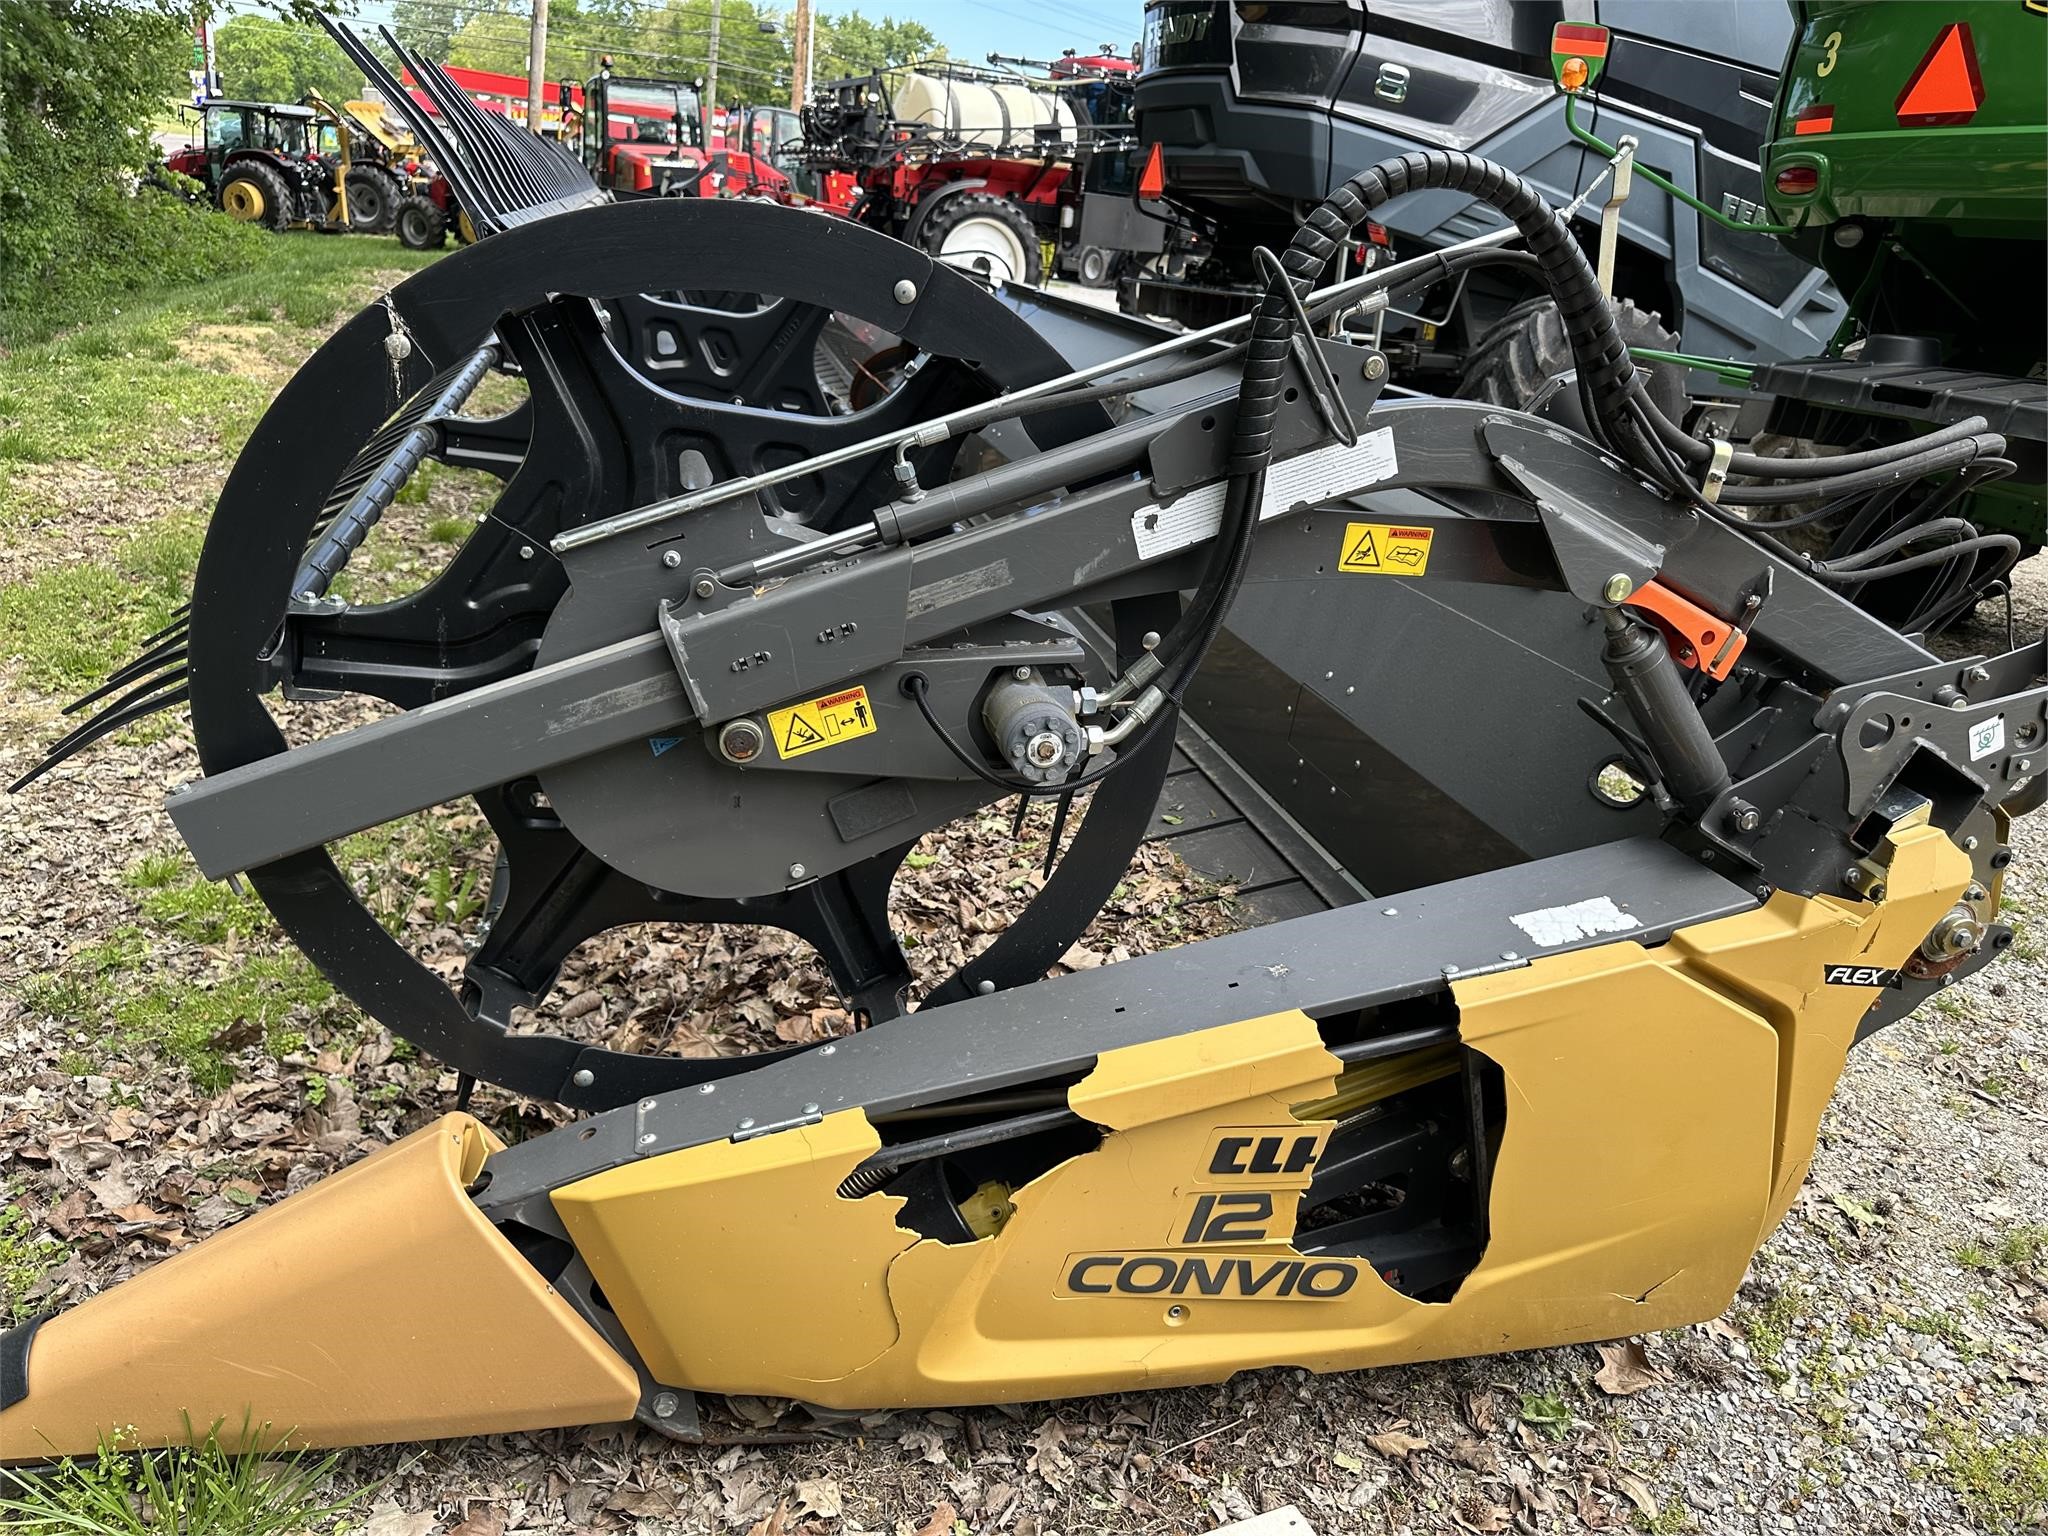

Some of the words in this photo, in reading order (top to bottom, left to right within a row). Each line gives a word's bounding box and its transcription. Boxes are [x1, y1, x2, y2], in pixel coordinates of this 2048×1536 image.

[1147, 12, 1212, 48] FENDT
[1817, 31, 1842, 78] 3
[1375, 62, 1410, 103] 8
[1397, 530, 1428, 538] WARNING
[827, 691, 861, 706] WARNING
[1827, 967, 1885, 985] FLEX
[1182, 1193, 1273, 1243] 12
[1068, 1256, 1359, 1297] CONVIO
